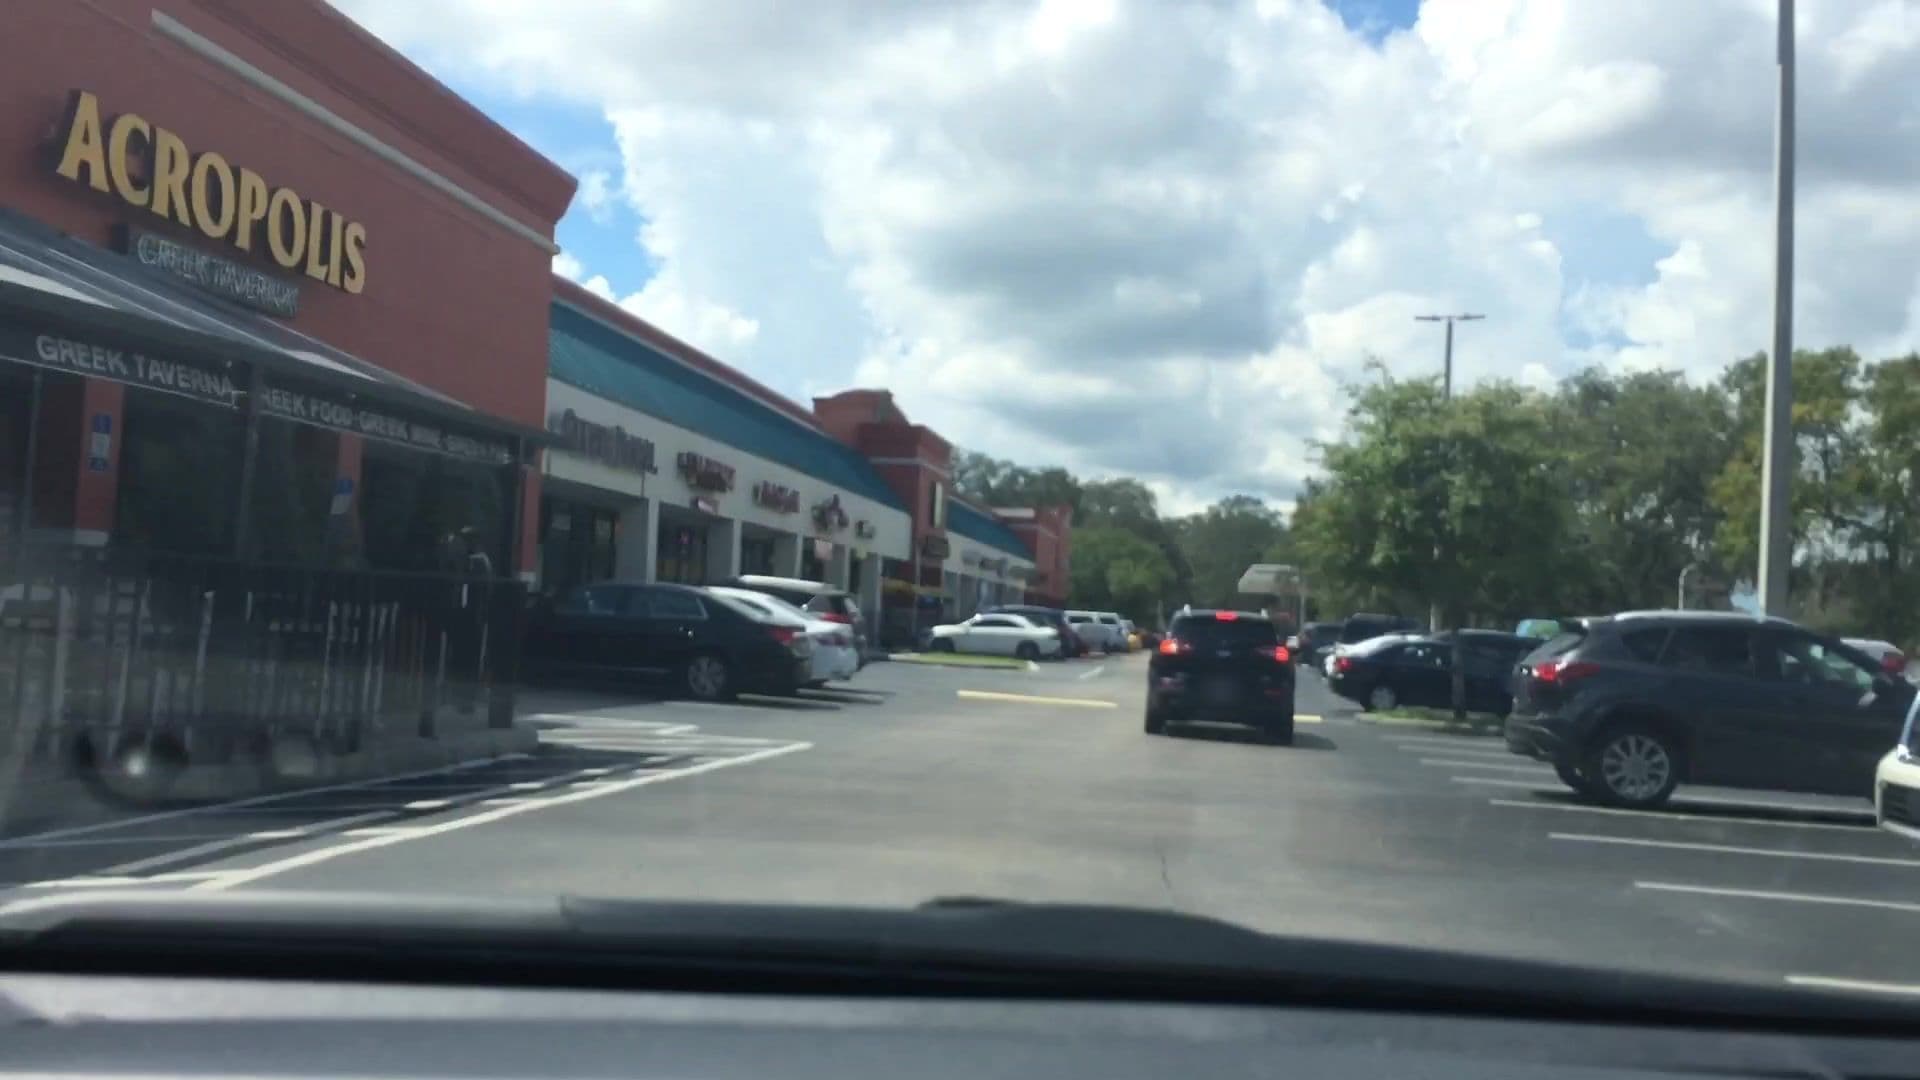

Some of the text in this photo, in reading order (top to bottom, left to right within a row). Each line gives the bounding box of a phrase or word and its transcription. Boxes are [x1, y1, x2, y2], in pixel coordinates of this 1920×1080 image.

[56, 90, 366, 294] ACROPOLIS
[36, 335, 234, 397] GREEK TAVERNA
